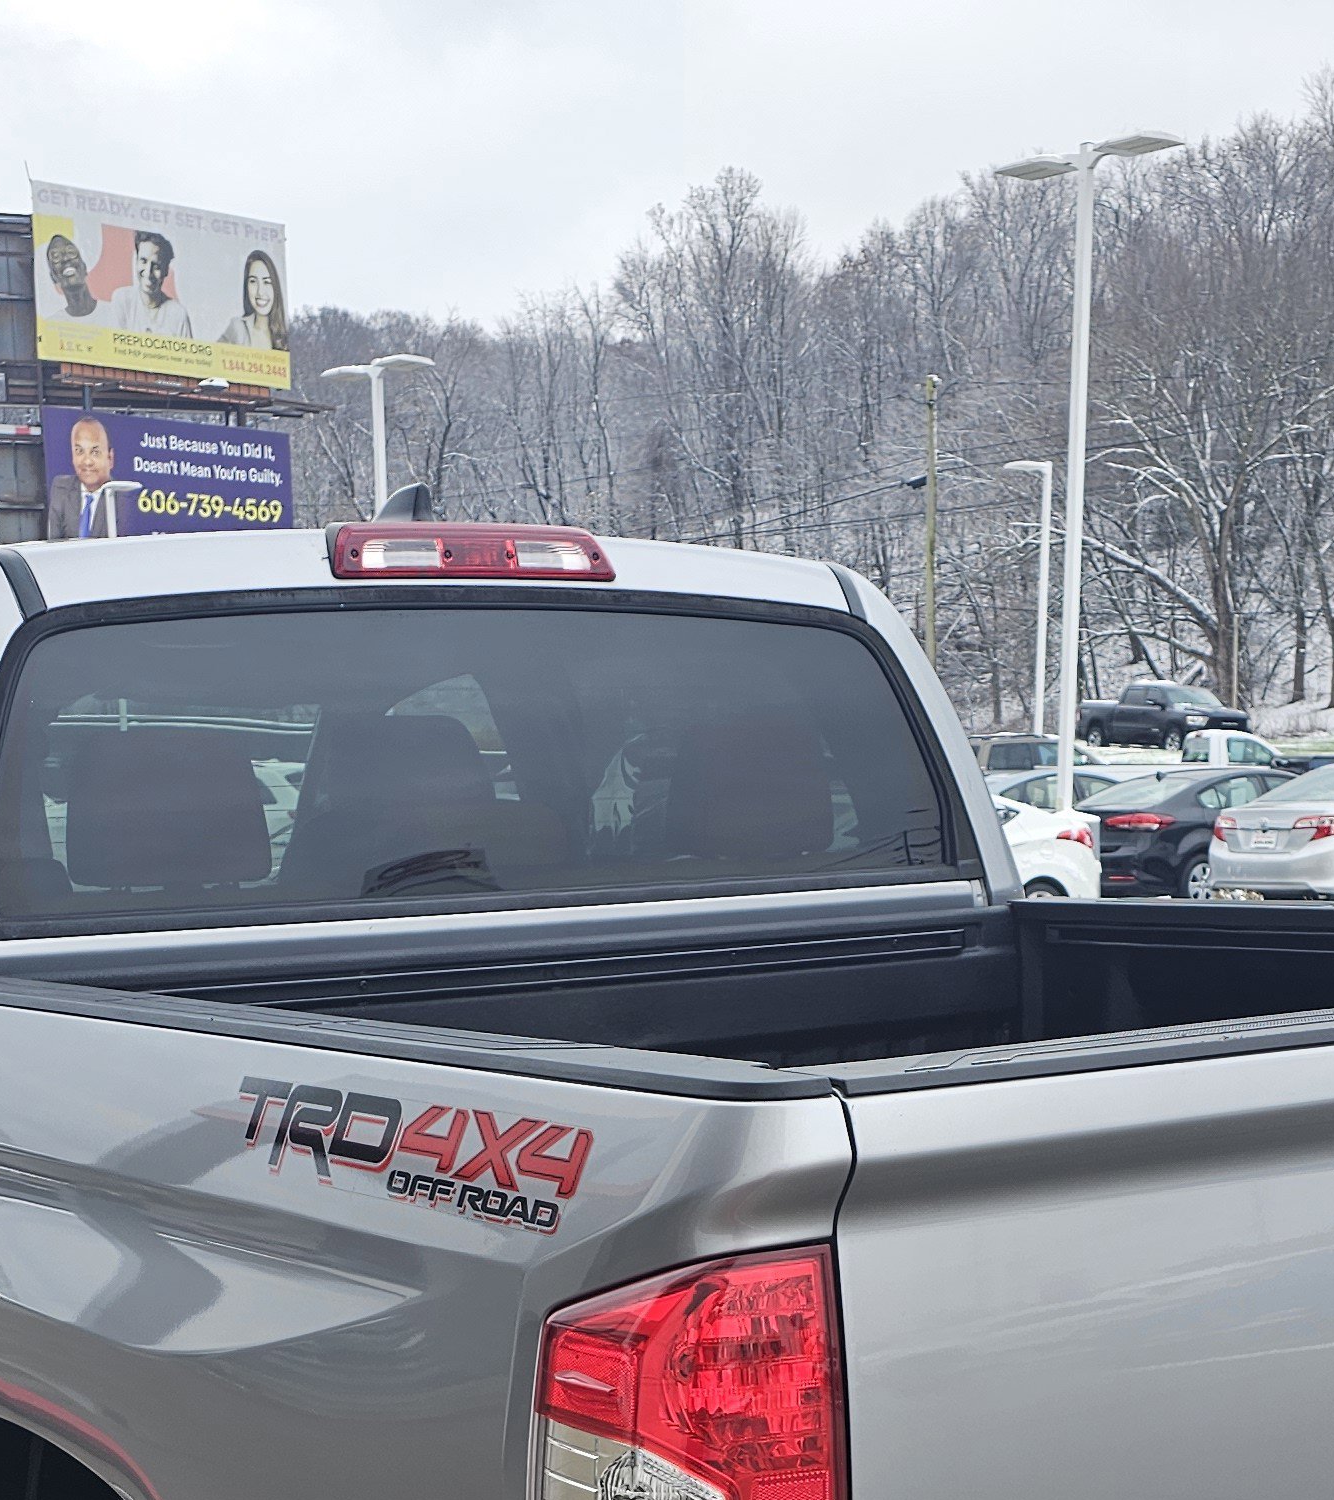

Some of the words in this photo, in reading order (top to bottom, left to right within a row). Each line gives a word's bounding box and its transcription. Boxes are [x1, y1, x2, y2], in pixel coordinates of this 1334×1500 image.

[38, 189, 71, 207] GET
[75, 194, 135, 219] READY.
[140, 206, 171, 225] GET
[211, 218, 239, 236] GET
[113, 333, 212, 356] PREPLOCATOR.ORG
[140, 432, 167, 449] Just
[169, 435, 218, 455] Because
[219, 440, 241, 457] You
[243, 442, 261, 459] Did
[264, 445, 275, 462] It,
[133, 456, 178, 475] Doesn't
[180, 461, 211, 478] Mean
[212, 464, 247, 482] You're
[248, 467, 283, 487] Guilty.
[137, 488, 283, 523] 606-739-4569
[239, 1075, 403, 1185] TRD
[397, 1103, 595, 1199] 4X4
[386, 1168, 457, 1208] OFF
[456, 1182, 562, 1236] ROAD
